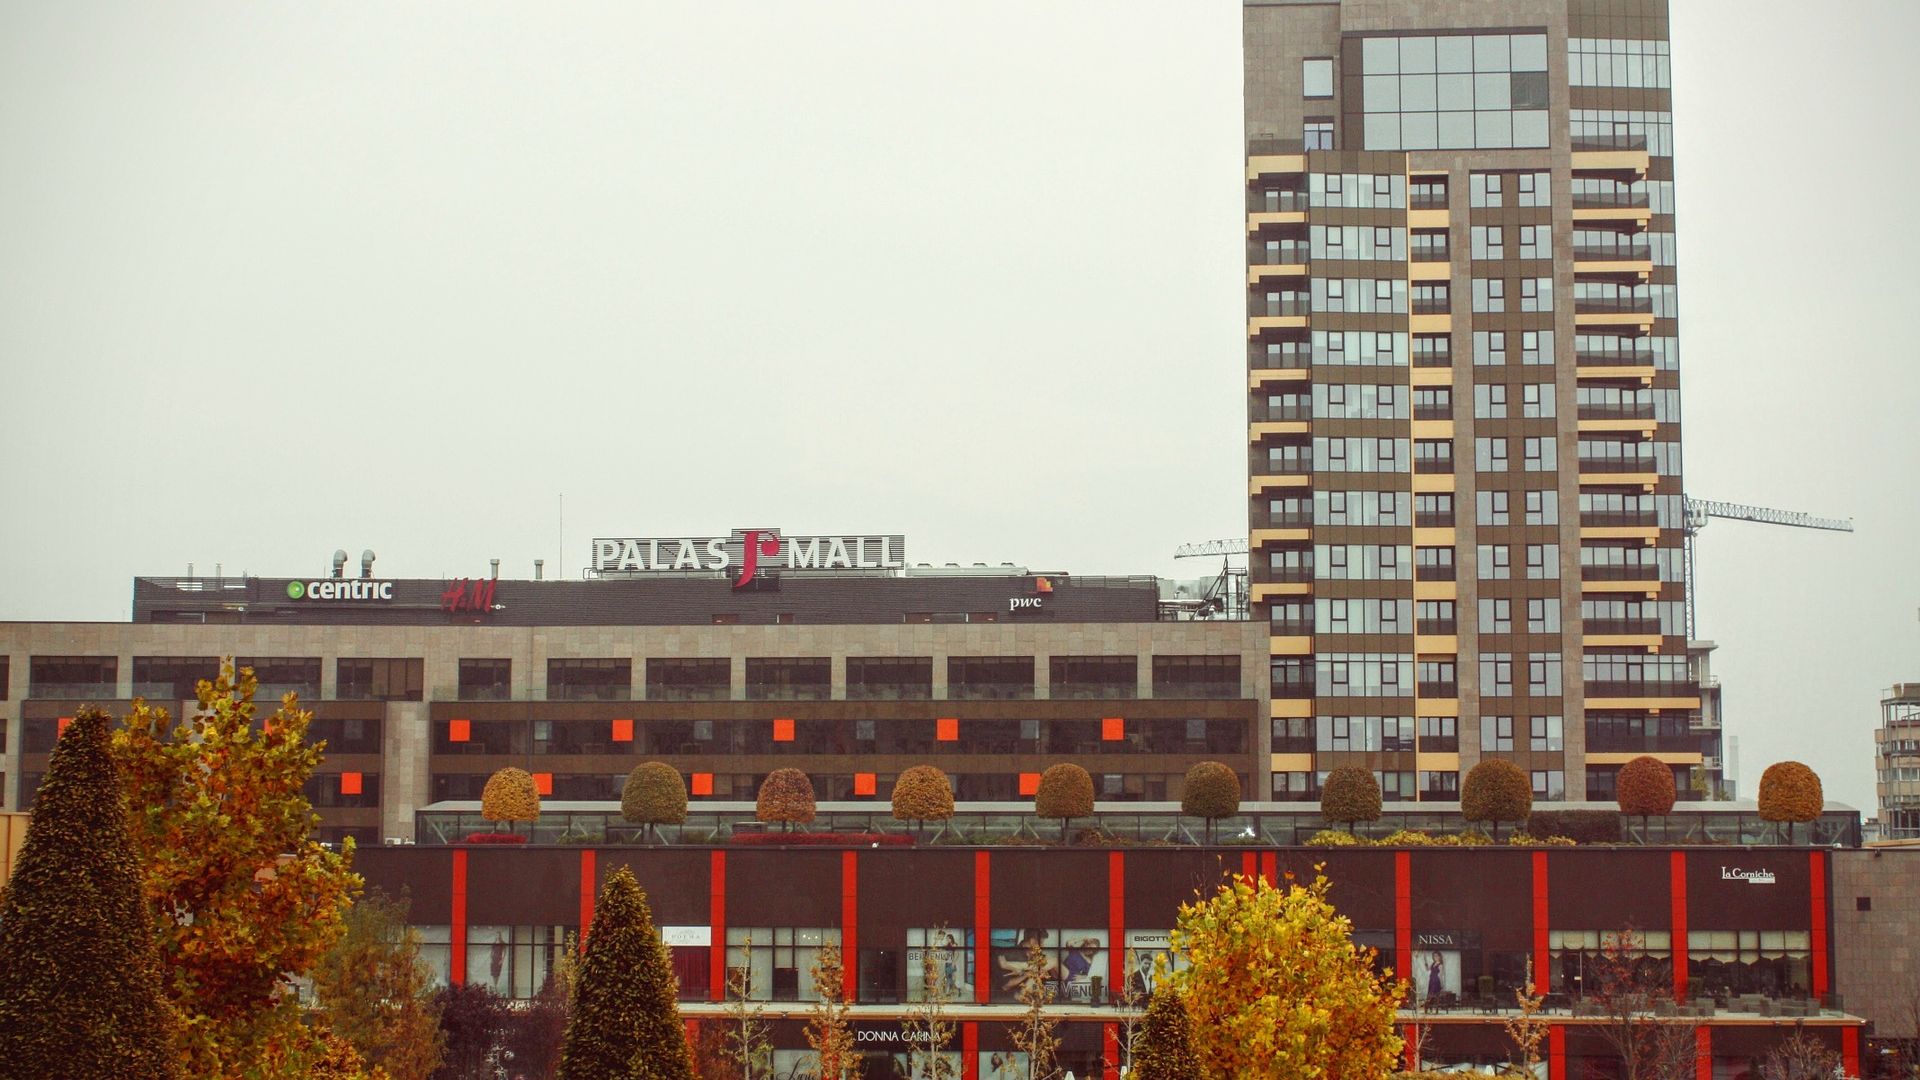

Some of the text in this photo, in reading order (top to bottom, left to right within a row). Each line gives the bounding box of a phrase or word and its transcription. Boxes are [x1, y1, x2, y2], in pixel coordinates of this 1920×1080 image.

[594, 538, 730, 571] PALAS
[787, 536, 902, 568] MALL
[307, 580, 392, 600] centric
[440, 577, 497, 614] H&M
[1009, 598, 1042, 611] pwc
[1721, 866, 1775, 880] La Corniche
[1418, 934, 1453, 945] NISSA
[857, 1031, 899, 1042] DONNA
